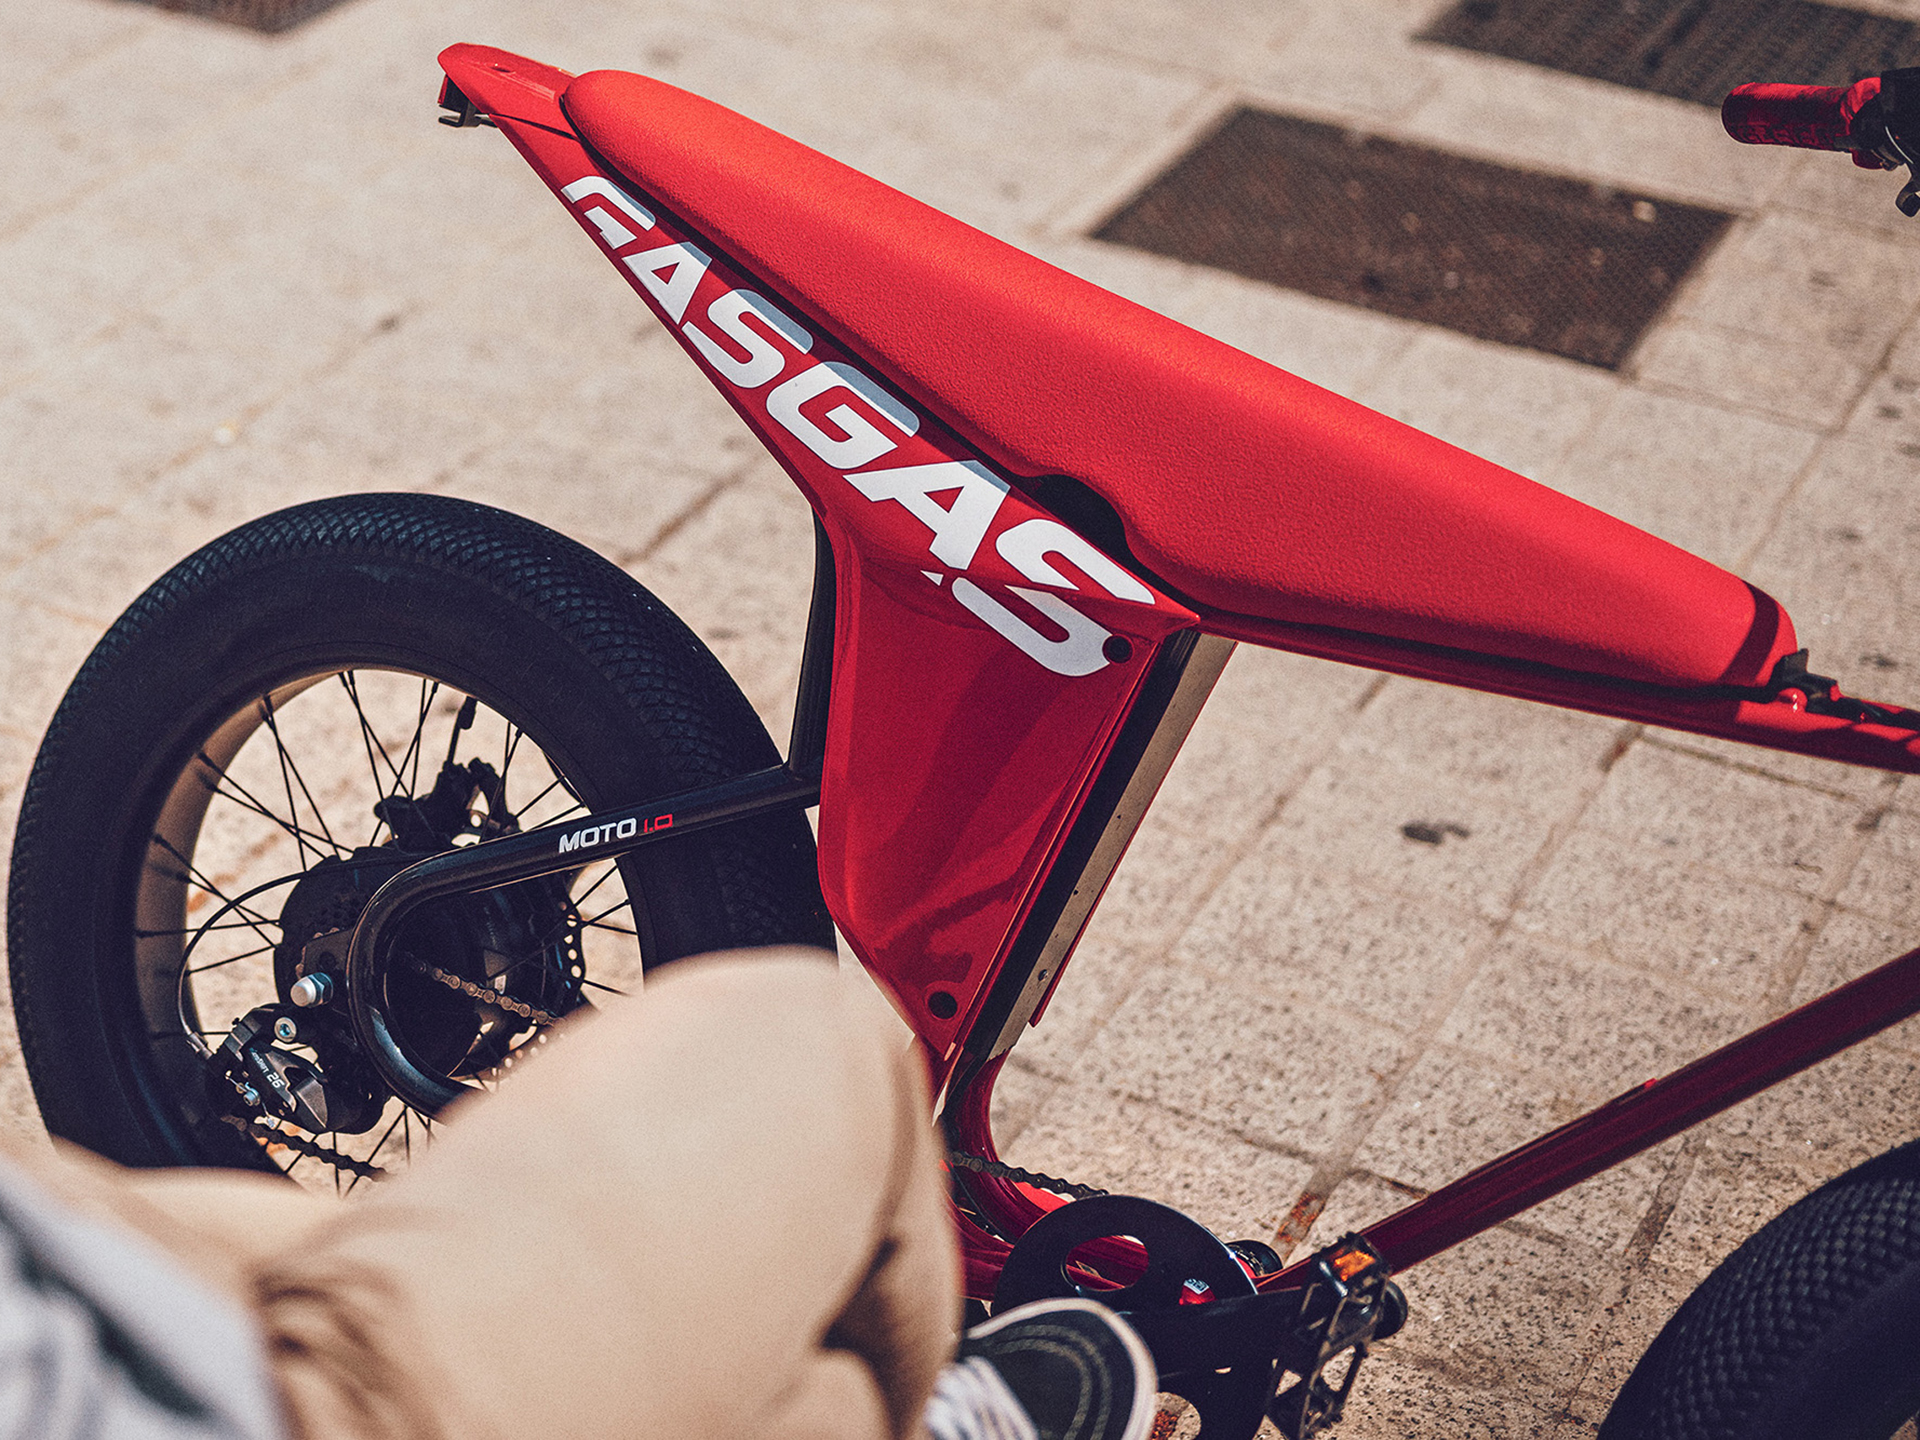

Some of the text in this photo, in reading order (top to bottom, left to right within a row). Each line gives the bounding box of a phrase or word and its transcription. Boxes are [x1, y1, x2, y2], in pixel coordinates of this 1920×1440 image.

[560, 176, 1156, 677] GASGAS
[558, 813, 673, 854] MOTO 1.0
[266, 1071, 286, 1089] 26
